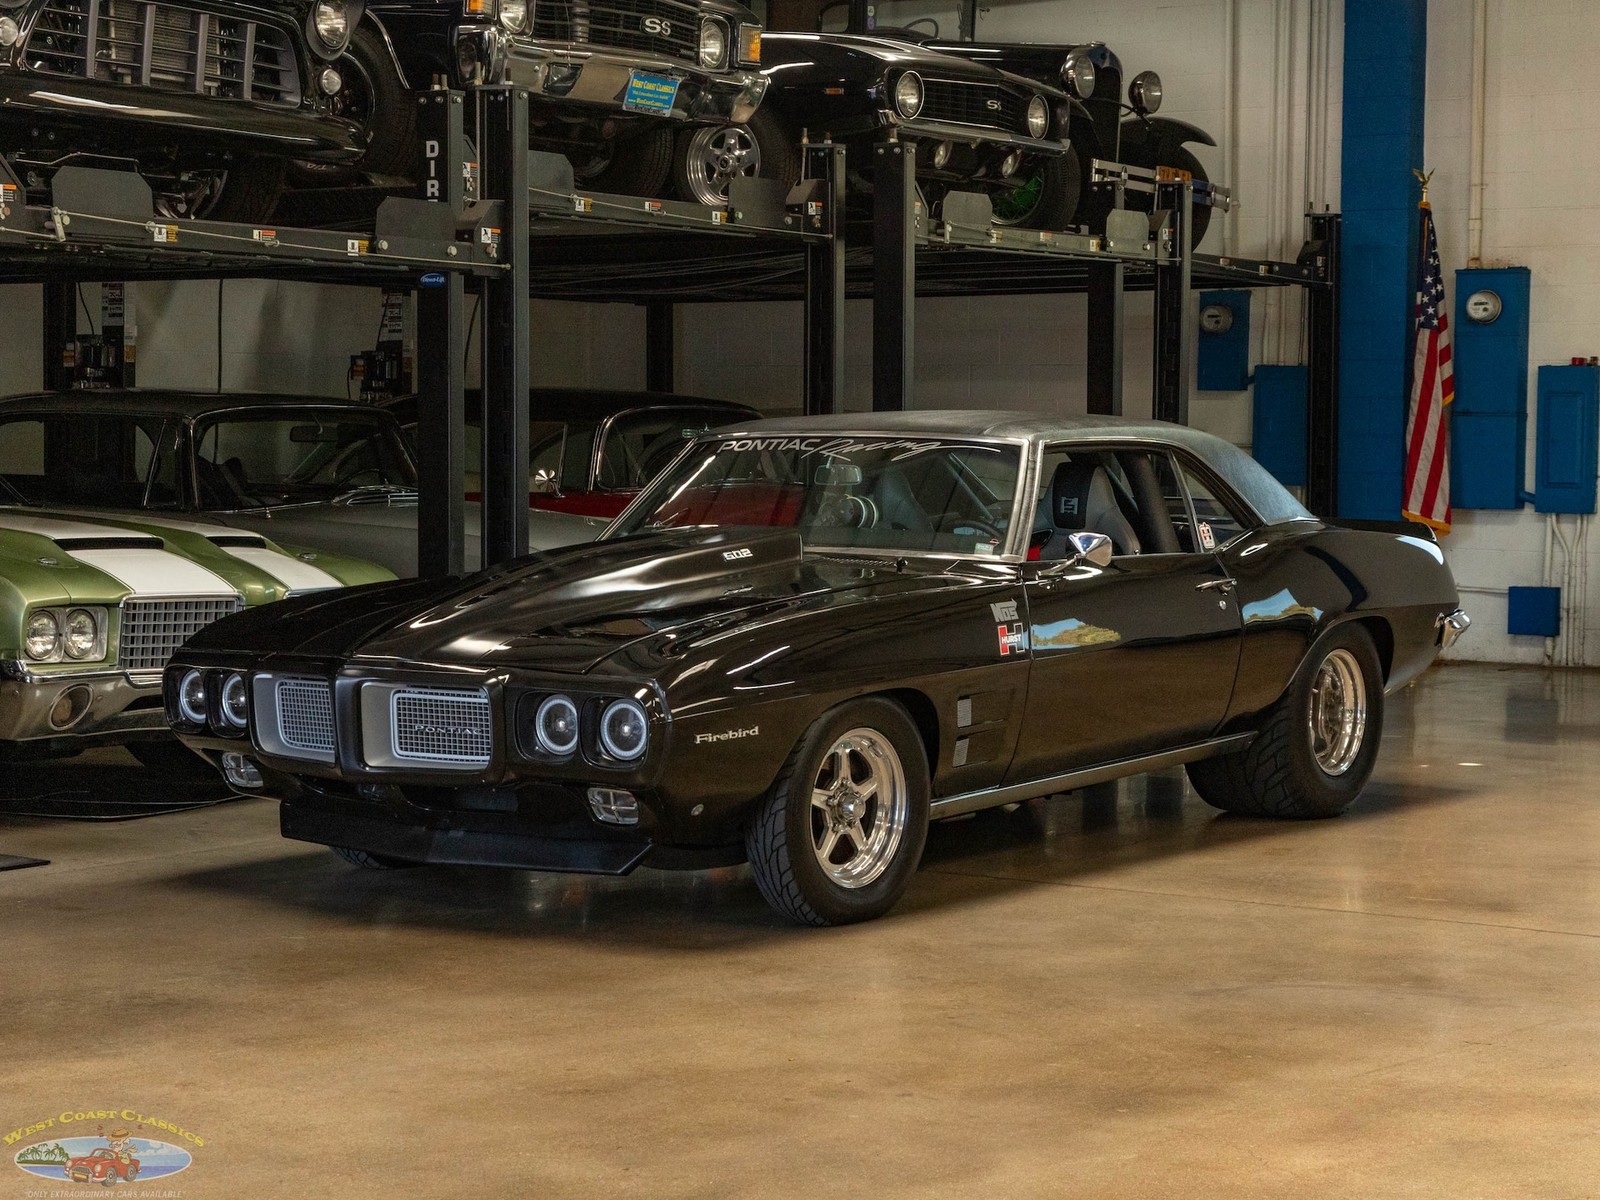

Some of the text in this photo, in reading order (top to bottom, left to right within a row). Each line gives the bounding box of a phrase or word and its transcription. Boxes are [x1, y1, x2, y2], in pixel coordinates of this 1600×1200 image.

[645, 18, 671, 35] SS
[425, 140, 440, 203] DIR
[717, 437, 990, 461] PONTIAC Racing
[722, 548, 754, 562] 502
[990, 598, 1020, 623] NOS
[1001, 633, 1022, 645] HURST
[415, 724, 482, 735] PONTIAC
[694, 724, 760, 745] Firebird
